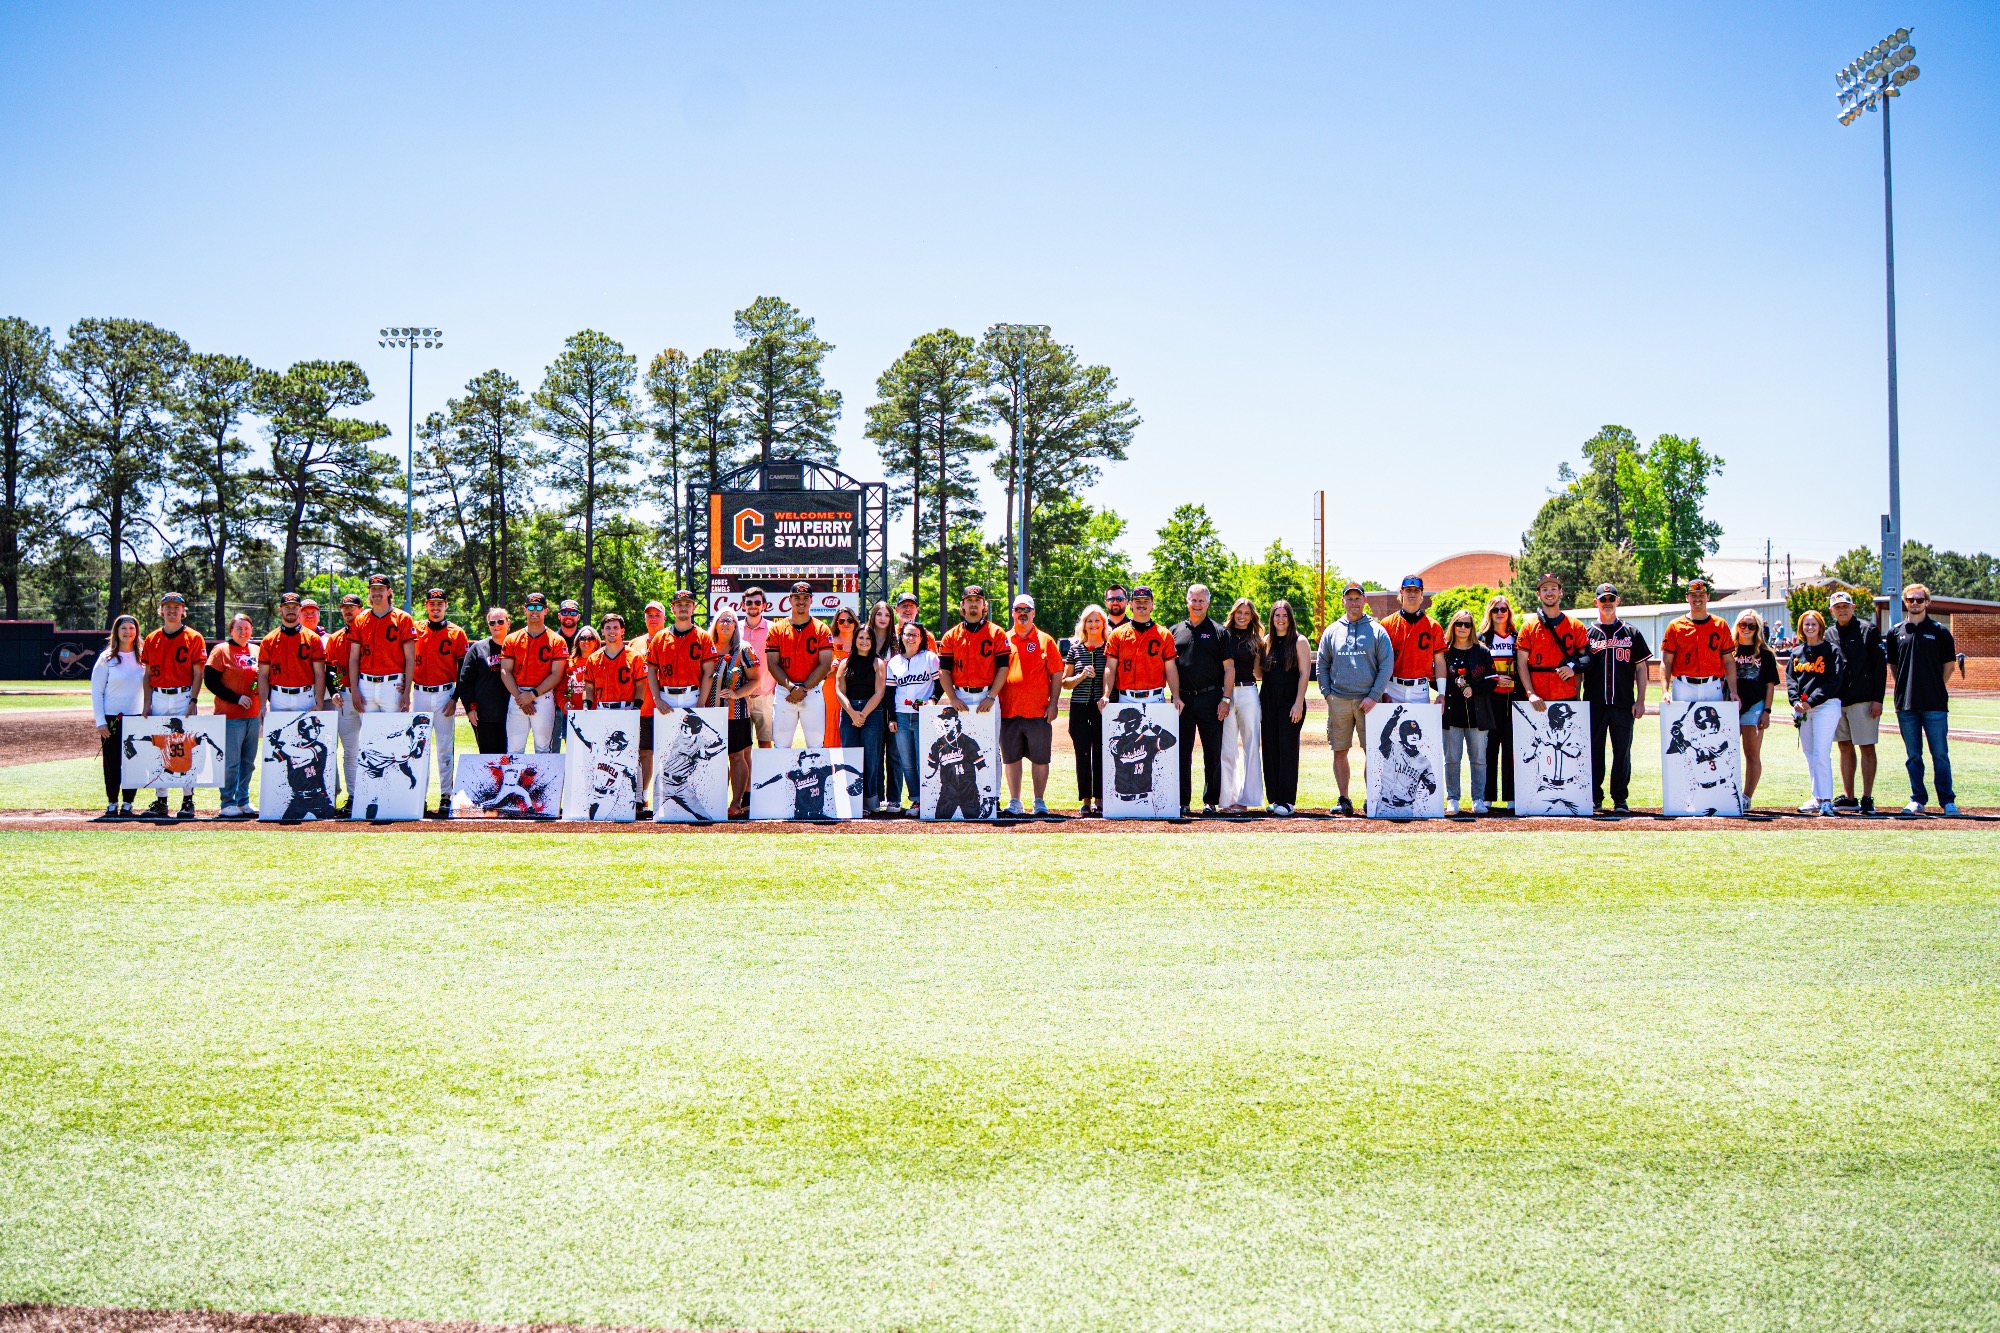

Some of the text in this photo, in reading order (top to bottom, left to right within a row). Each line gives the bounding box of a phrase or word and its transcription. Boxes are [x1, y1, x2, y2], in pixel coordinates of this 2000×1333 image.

[774, 512, 835, 520] WELCOME
[734, 508, 764, 552] C
[774, 521, 853, 534] JIM PERRY
[774, 535, 852, 548] STADIUM
[824, 598, 839, 606] IGA
[386, 624, 398, 642] C
[1418, 632, 1431, 650] C
[1707, 632, 1720, 650] C
[298, 643, 310, 660] C
[439, 639, 452, 655] C
[539, 645, 551, 662] C
[690, 642, 701, 660] C
[806, 636, 818, 655] C
[980, 639, 993, 657] C
[1148, 639, 1160, 656] C
[175, 646, 188, 664] C
[1685, 653, 1691, 665] 3
[1123, 659, 1131, 672] 13
[619, 666, 630, 684] C
[170, 742, 184, 757] 35
[605, 778, 615, 786] 17
